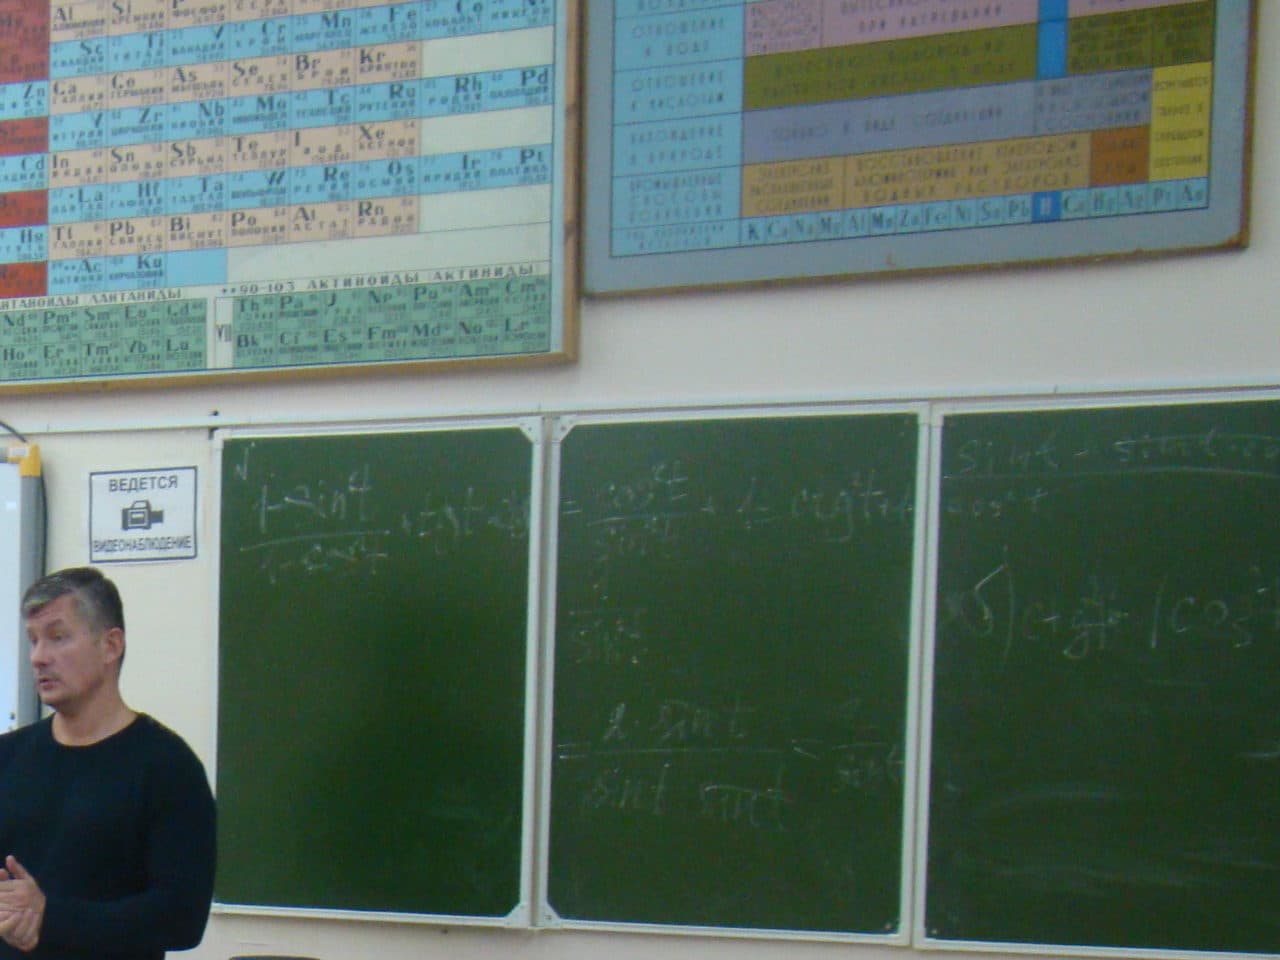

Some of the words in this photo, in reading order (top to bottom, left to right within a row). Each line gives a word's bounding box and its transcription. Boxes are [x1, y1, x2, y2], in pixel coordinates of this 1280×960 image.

[54, 7, 73, 21] Al
[144, 32, 164, 48] Ti
[322, 12, 351, 29] Mn
[389, 7, 417, 22] Fe
[23, 84, 45, 99] Zn
[174, 67, 197, 83] As
[232, 62, 259, 77] Se
[296, 54, 320, 70] Br
[360, 49, 385, 64] Kr
[139, 107, 163, 123] Zr
[199, 102, 225, 117] Nb
[256, 95, 287, 110] Mo
[389, 84, 416, 99] Ru
[455, 75, 482, 93] Rh
[522, 68, 549, 87] Pd
[20, 156, 45, 171] Cd
[52, 154, 69, 169] In
[111, 149, 135, 163] Sn
[172, 142, 196, 158] Sb
[231, 136, 258, 152] Te
[359, 125, 385, 140] Xe
[138, 182, 160, 198] Hf
[200, 177, 224, 193] Ta
[324, 166, 350, 181] Re
[388, 160, 415, 176] Os
[463, 154, 481, 170] Ir
[521, 149, 544, 165] Pt
[53, 226, 73, 241] Tl
[110, 221, 135, 236] Pb
[170, 217, 191, 232] Bi
[231, 211, 258, 227] Po
[294, 206, 316, 222] At
[358, 200, 385, 216] Rn
[78, 259, 103, 273] Ac
[137, 254, 162, 270] Ku
[307, 271, 419, 290] АКТИНОИДЫ
[432, 264, 533, 282] АКТИНИДЫ
[91, 288, 182, 305] ЛАНТАНИДЫ
[238, 297, 259, 312] Th
[280, 295, 304, 310] Pa
[367, 289, 393, 305] Np
[414, 286, 438, 301] Pu
[460, 282, 489, 297] Am
[506, 280, 537, 294] Cm
[43, 310, 70, 324] Pm
[84, 307, 110, 321] Sm
[237, 334, 259, 348] Bk
[324, 329, 347, 343] Es
[368, 326, 396, 341] Fm
[413, 321, 441, 337] Md
[505, 318, 528, 332] Lr
[3, 348, 25, 361] Ho
[85, 343, 109, 356] Tm
[166, 338, 189, 352] Lu
[109, 475, 178, 492] ВЕДЕТСЯ
